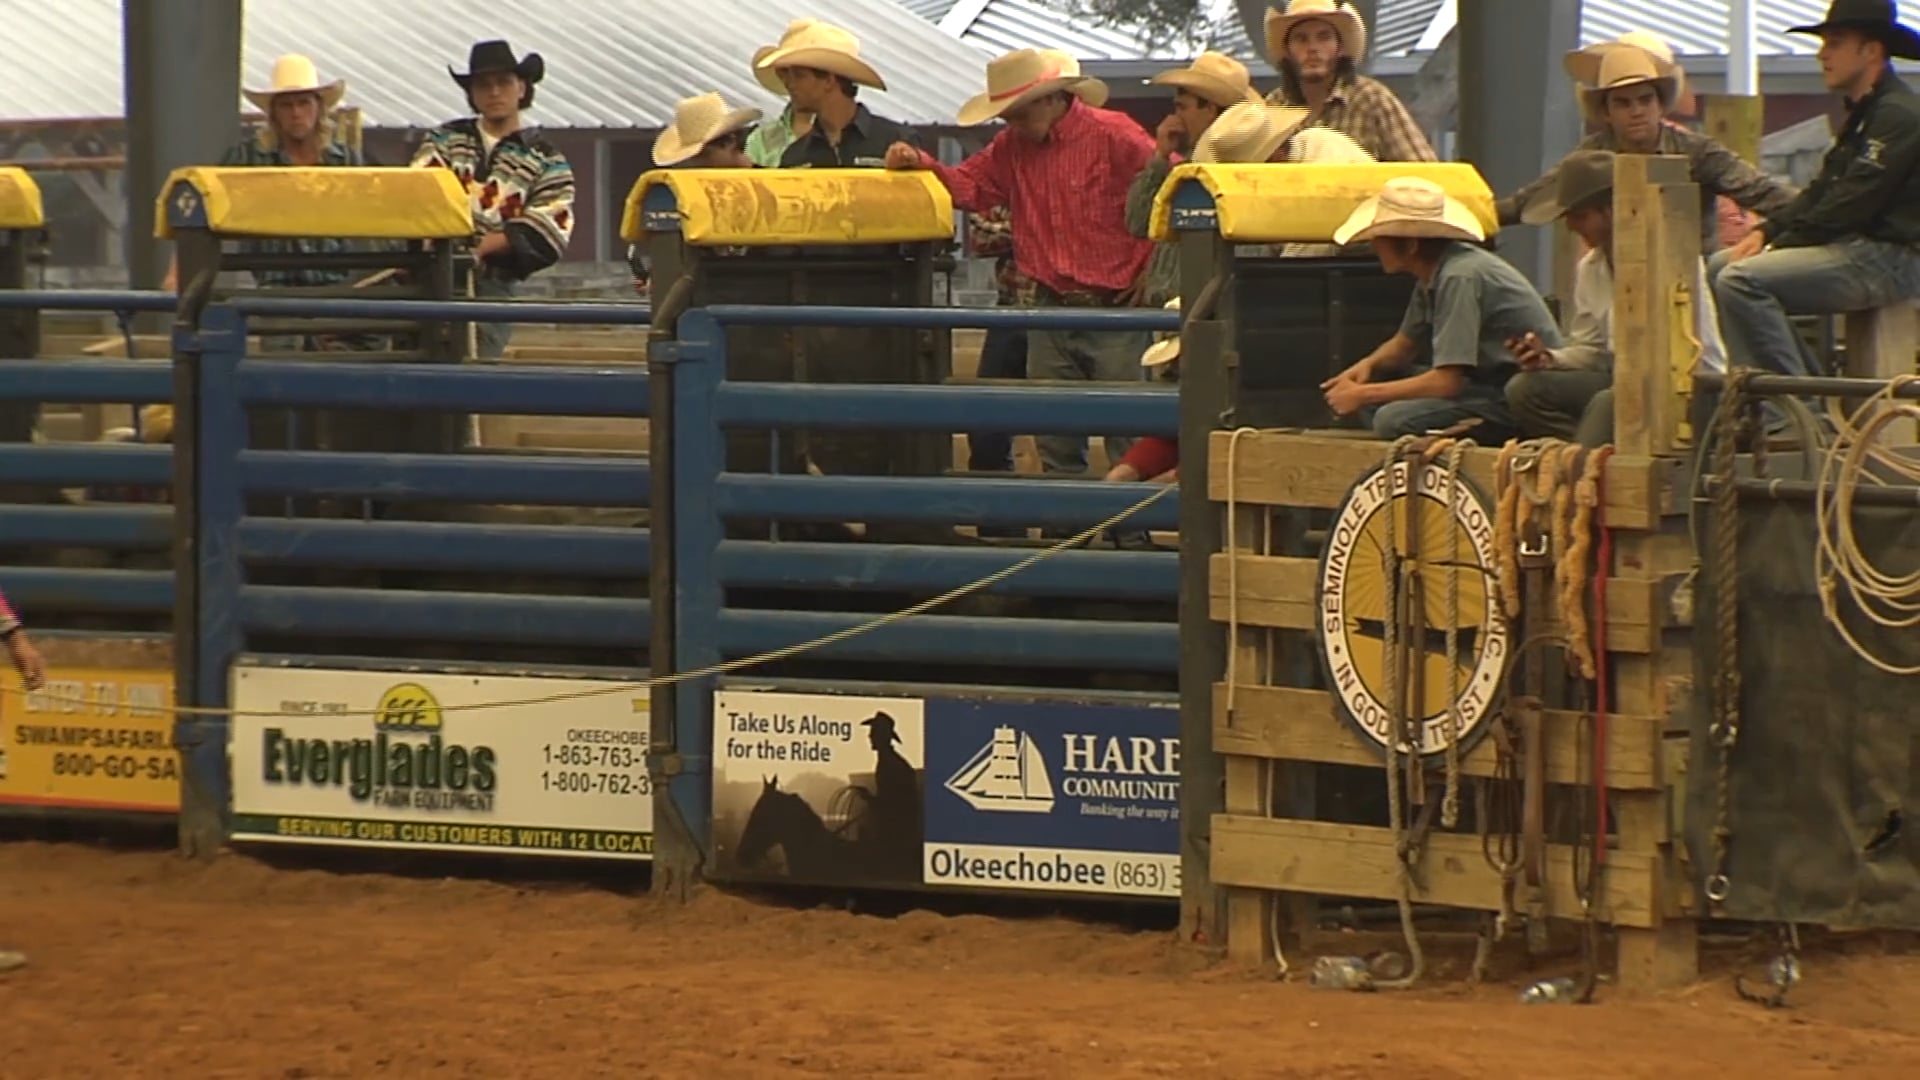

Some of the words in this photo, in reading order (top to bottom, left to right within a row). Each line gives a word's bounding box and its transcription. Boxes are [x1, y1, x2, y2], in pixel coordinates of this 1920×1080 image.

[1326, 497, 1368, 634] SEMINOLE
[1365, 467, 1409, 503] TRB
[1423, 468, 1450, 494] OF
[1335, 662, 1356, 692] IN
[1352, 691, 1391, 738] GOD
[566, 728, 648, 746] OKEECHOBE
[727, 712, 769, 733] Take
[773, 714, 796, 734] Us
[799, 714, 852, 742] Along
[263, 727, 498, 800] Everglades
[727, 737, 754, 759] for
[757, 740, 787, 761] the
[790, 741, 831, 763] Ride
[53, 751, 178, 780] 800-GO-SA
[413, 790, 495, 812] EQUIPMENT
[1062, 776, 1181, 801] COMMUNIT
[1080, 802, 1126, 820] Banking
[1127, 803, 1145, 818] the
[1146, 808, 1169, 822] way
[277, 817, 353, 839] SERVING
[357, 820, 395, 841] OUR
[399, 823, 513, 846] CUSTOMERS
[518, 828, 563, 848] WITH
[569, 831, 588, 850] 12
[593, 832, 653, 853] LOCAT
[930, 848, 1106, 885] Okeechobee
[1113, 859, 1167, 892] (863)
